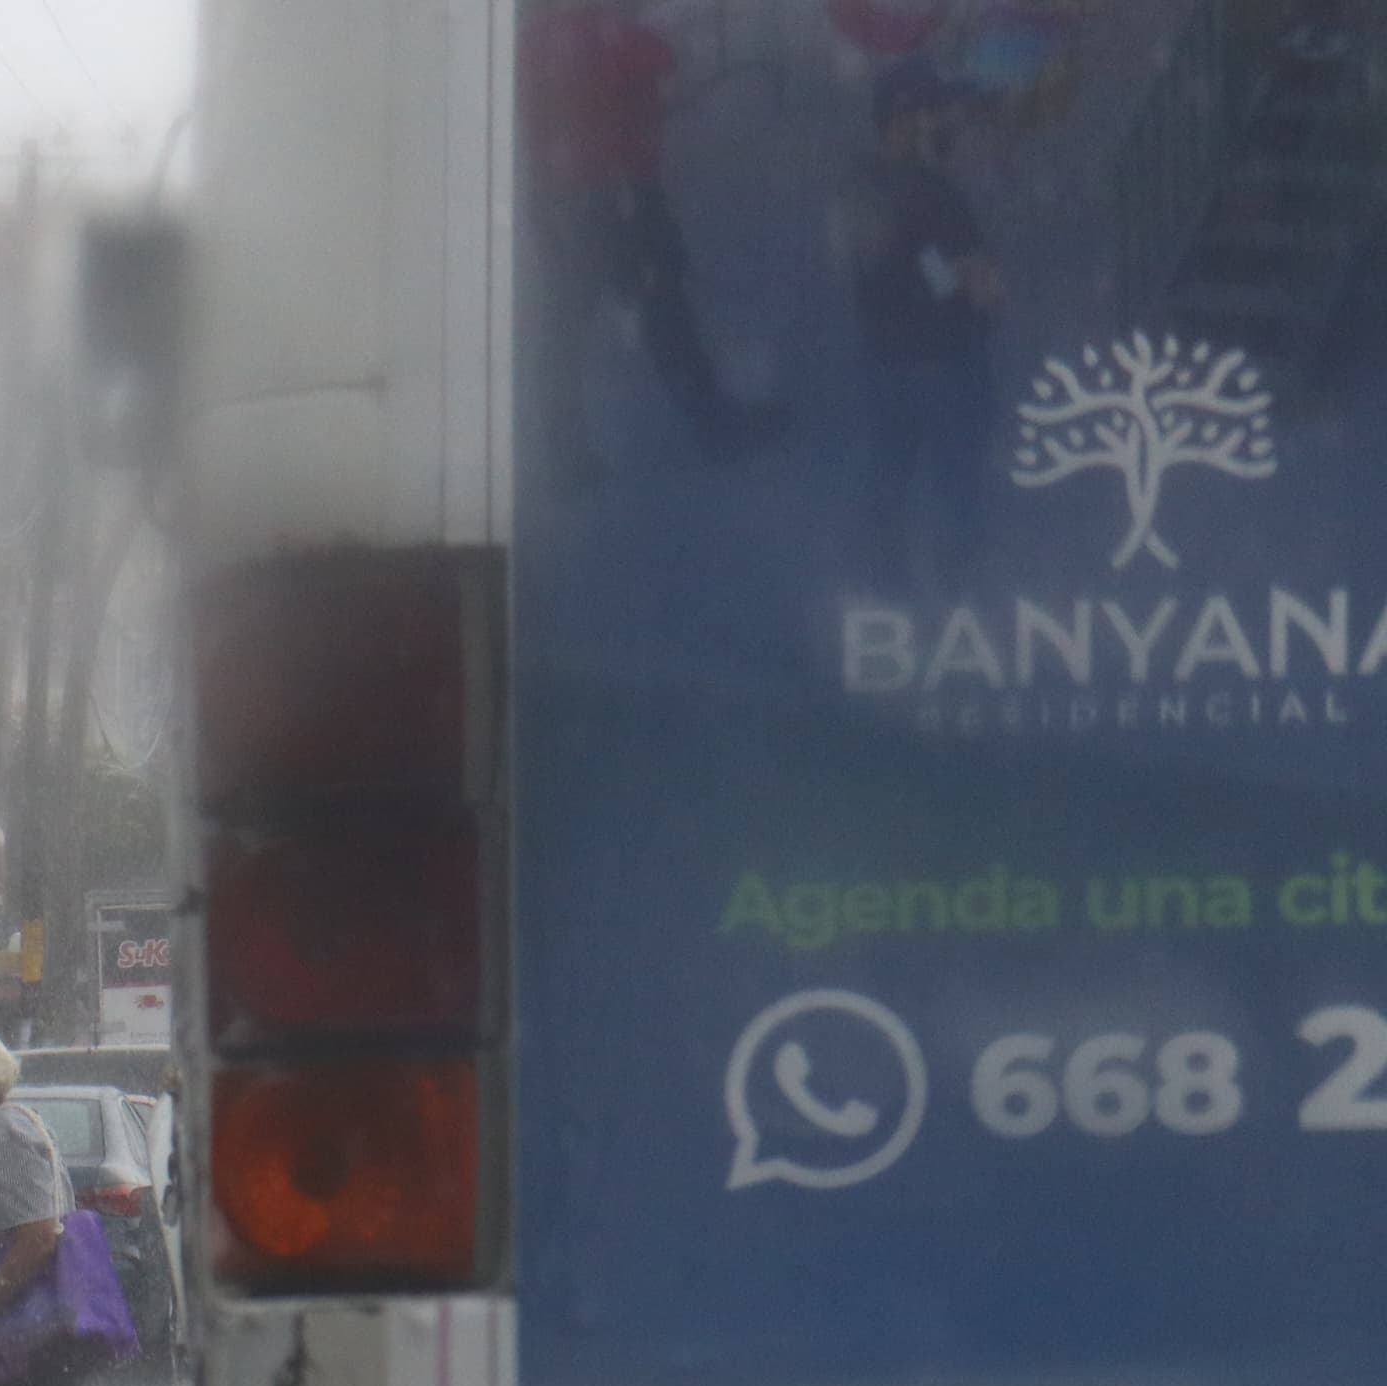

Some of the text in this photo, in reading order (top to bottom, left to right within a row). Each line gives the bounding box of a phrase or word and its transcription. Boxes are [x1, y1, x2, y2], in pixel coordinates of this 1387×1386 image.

[721, 864, 1059, 950] Agenda
[1087, 872, 1251, 931] una
[968, 1030, 1244, 1138] 668
